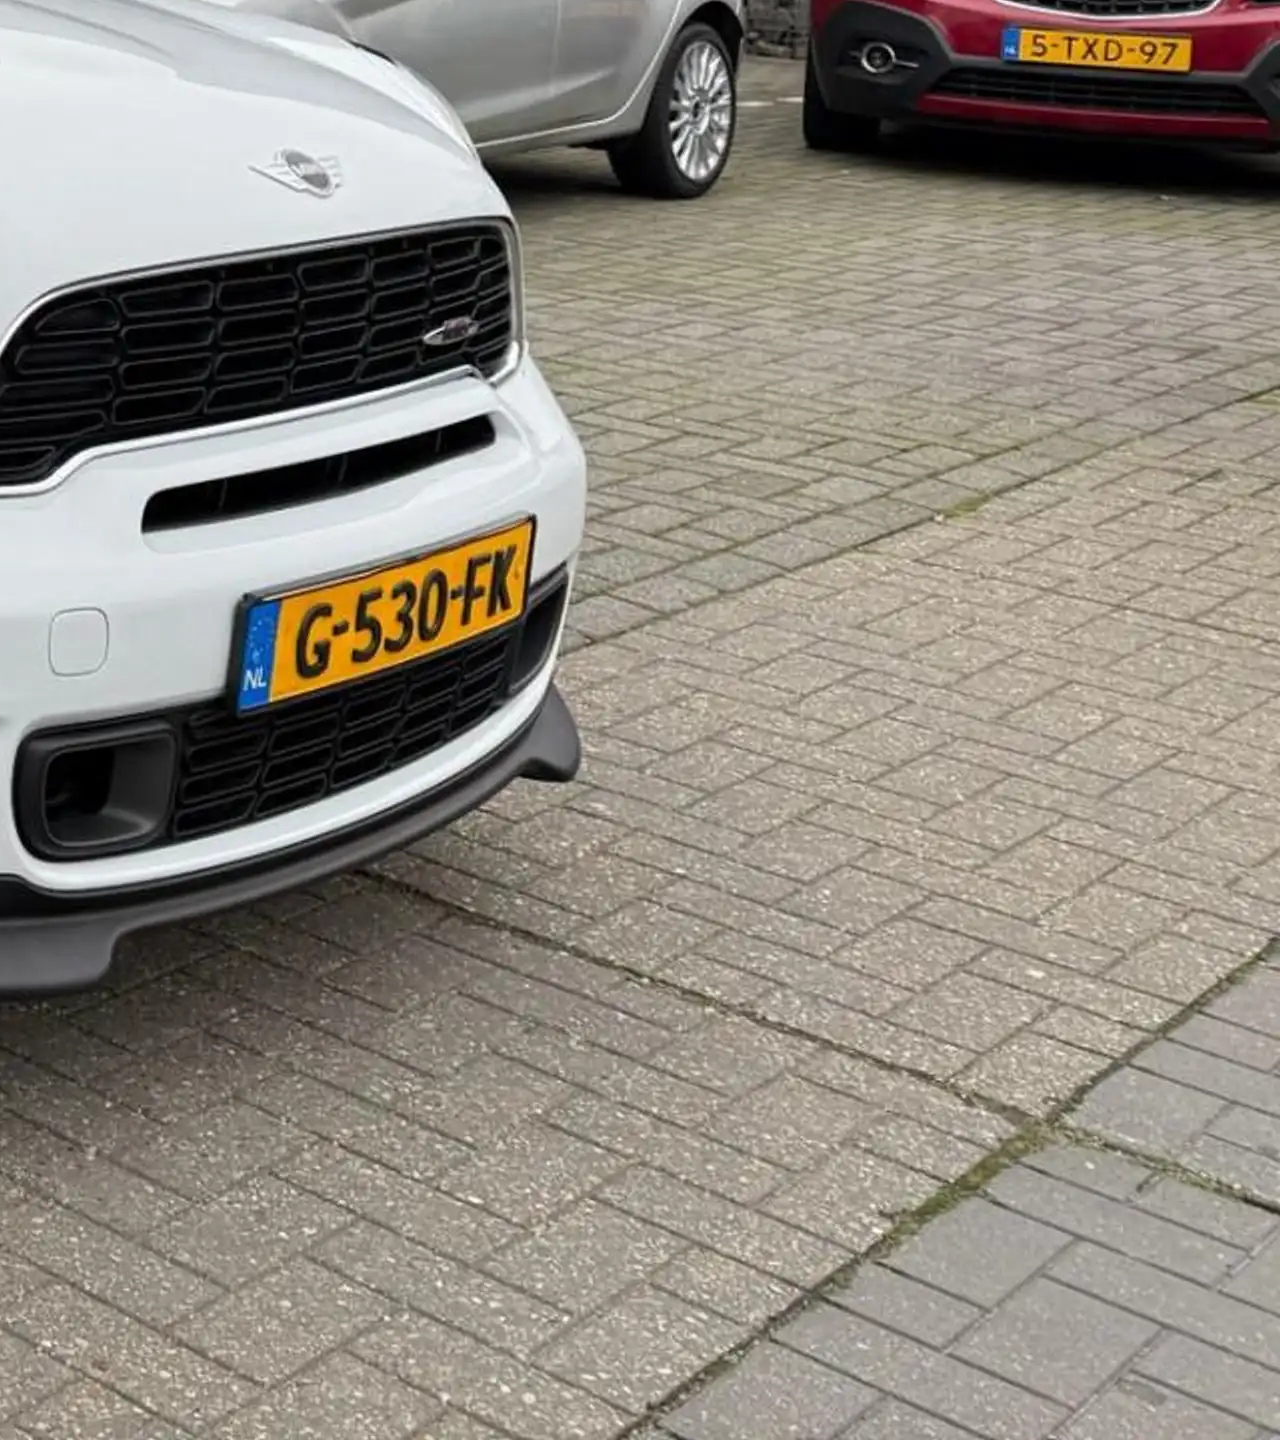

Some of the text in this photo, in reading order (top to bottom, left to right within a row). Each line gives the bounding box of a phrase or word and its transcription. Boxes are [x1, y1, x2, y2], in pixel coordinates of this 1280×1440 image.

[1031, 34, 1179, 65] 5-TXD-97
[296, 544, 517, 679] G-530-FK
[243, 665, 267, 691] NL
